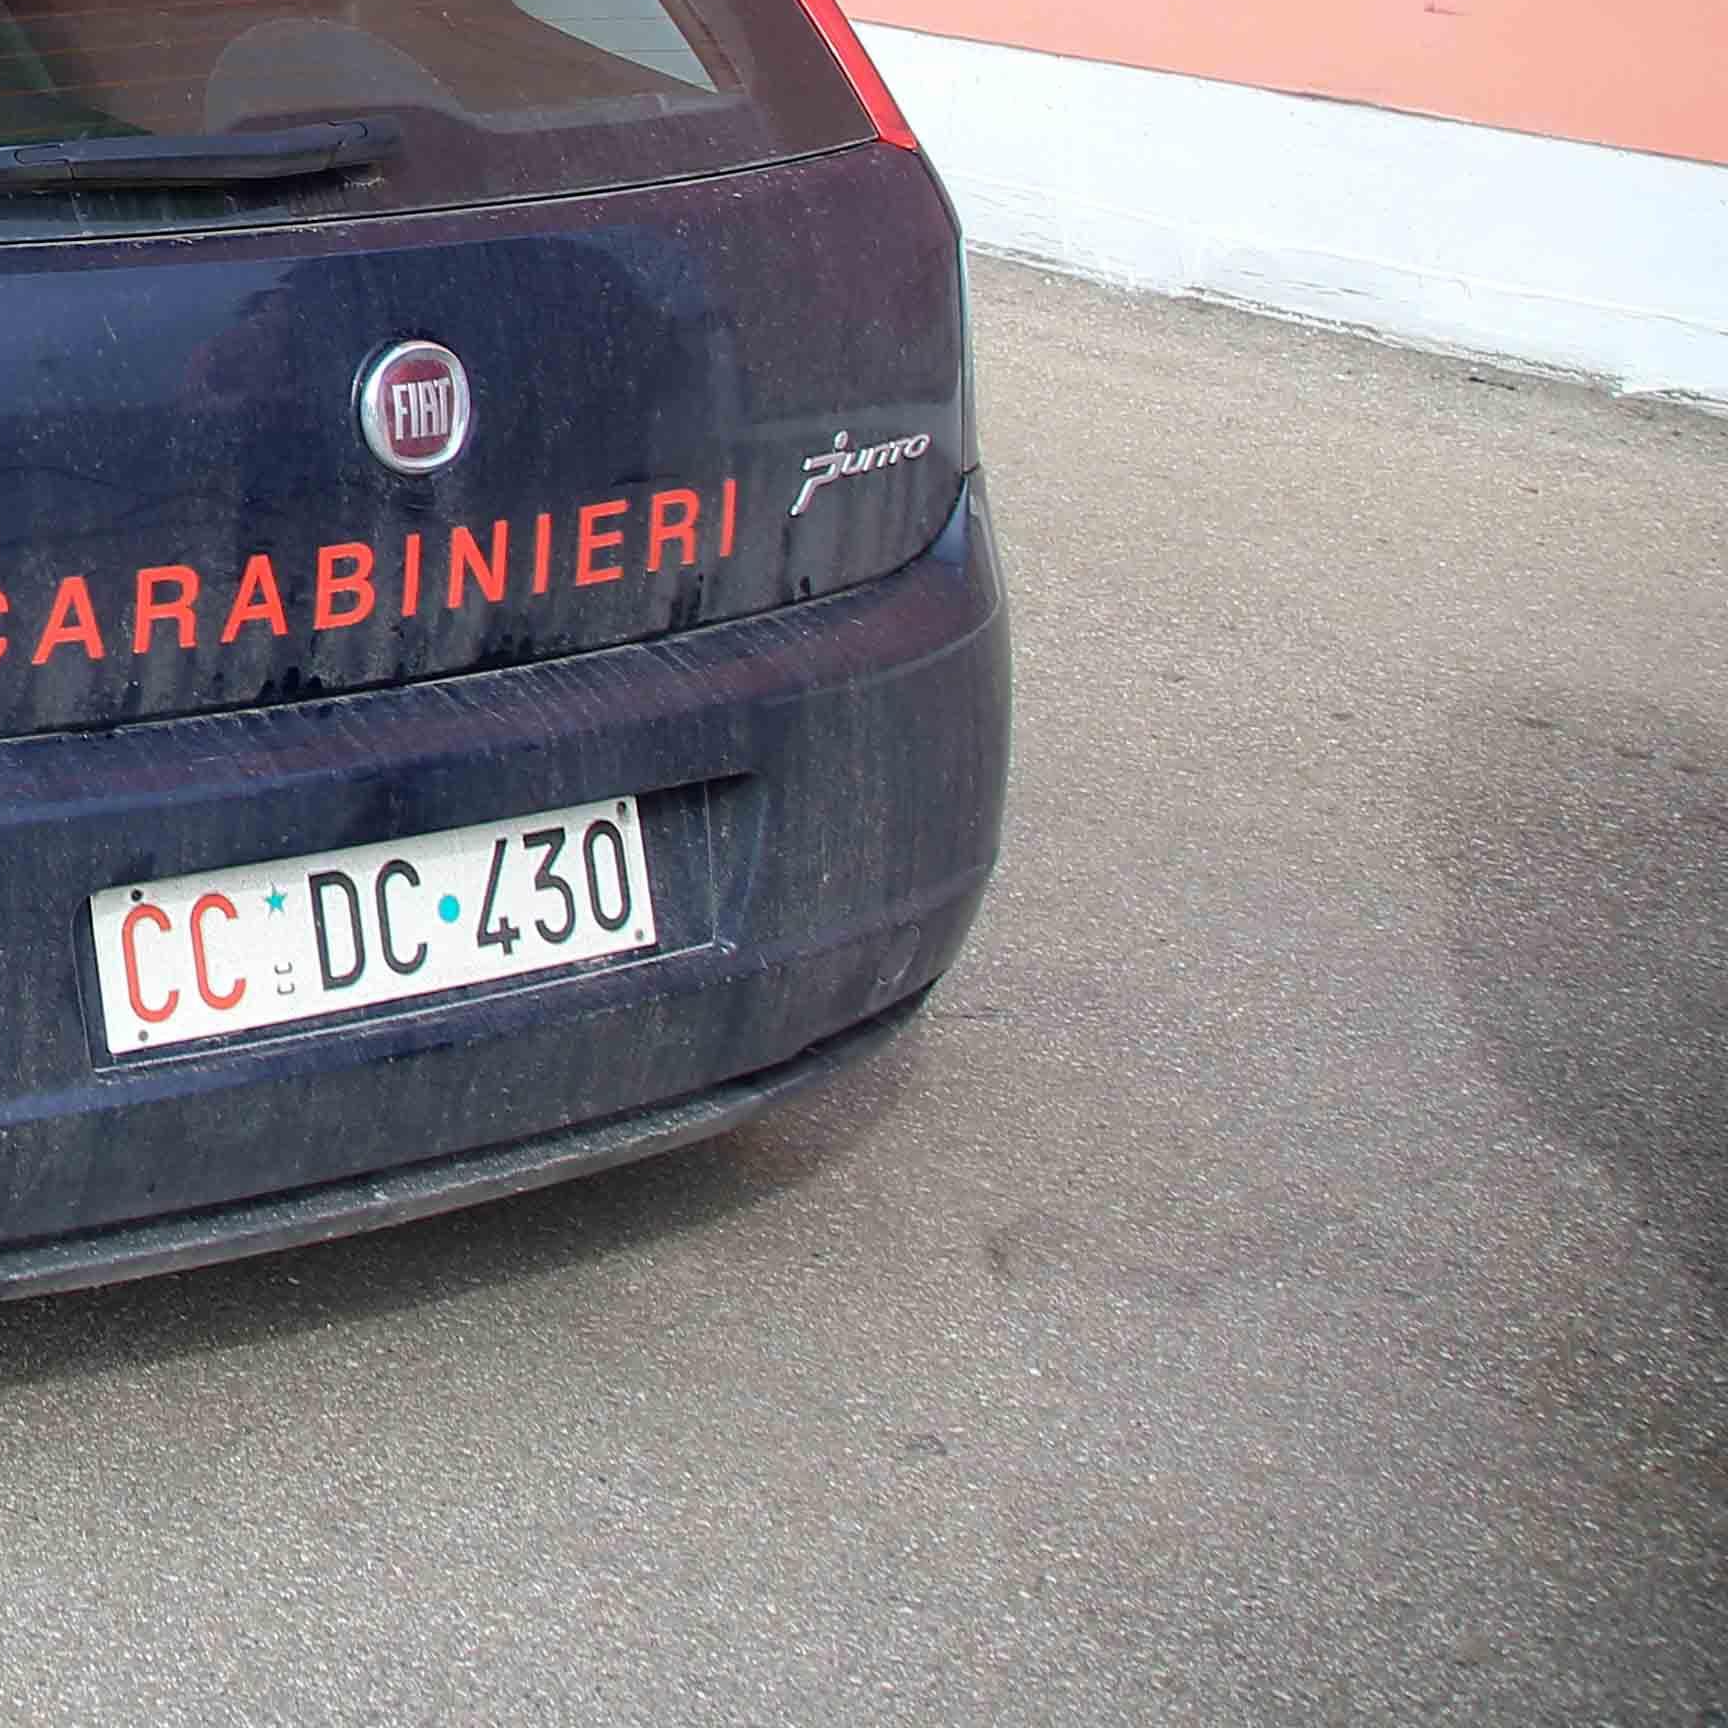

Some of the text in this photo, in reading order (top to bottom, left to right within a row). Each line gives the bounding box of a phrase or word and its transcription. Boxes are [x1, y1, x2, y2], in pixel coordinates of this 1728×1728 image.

[392, 377, 452, 440] FIAT
[121, 819, 632, 1023] CC DC 430
